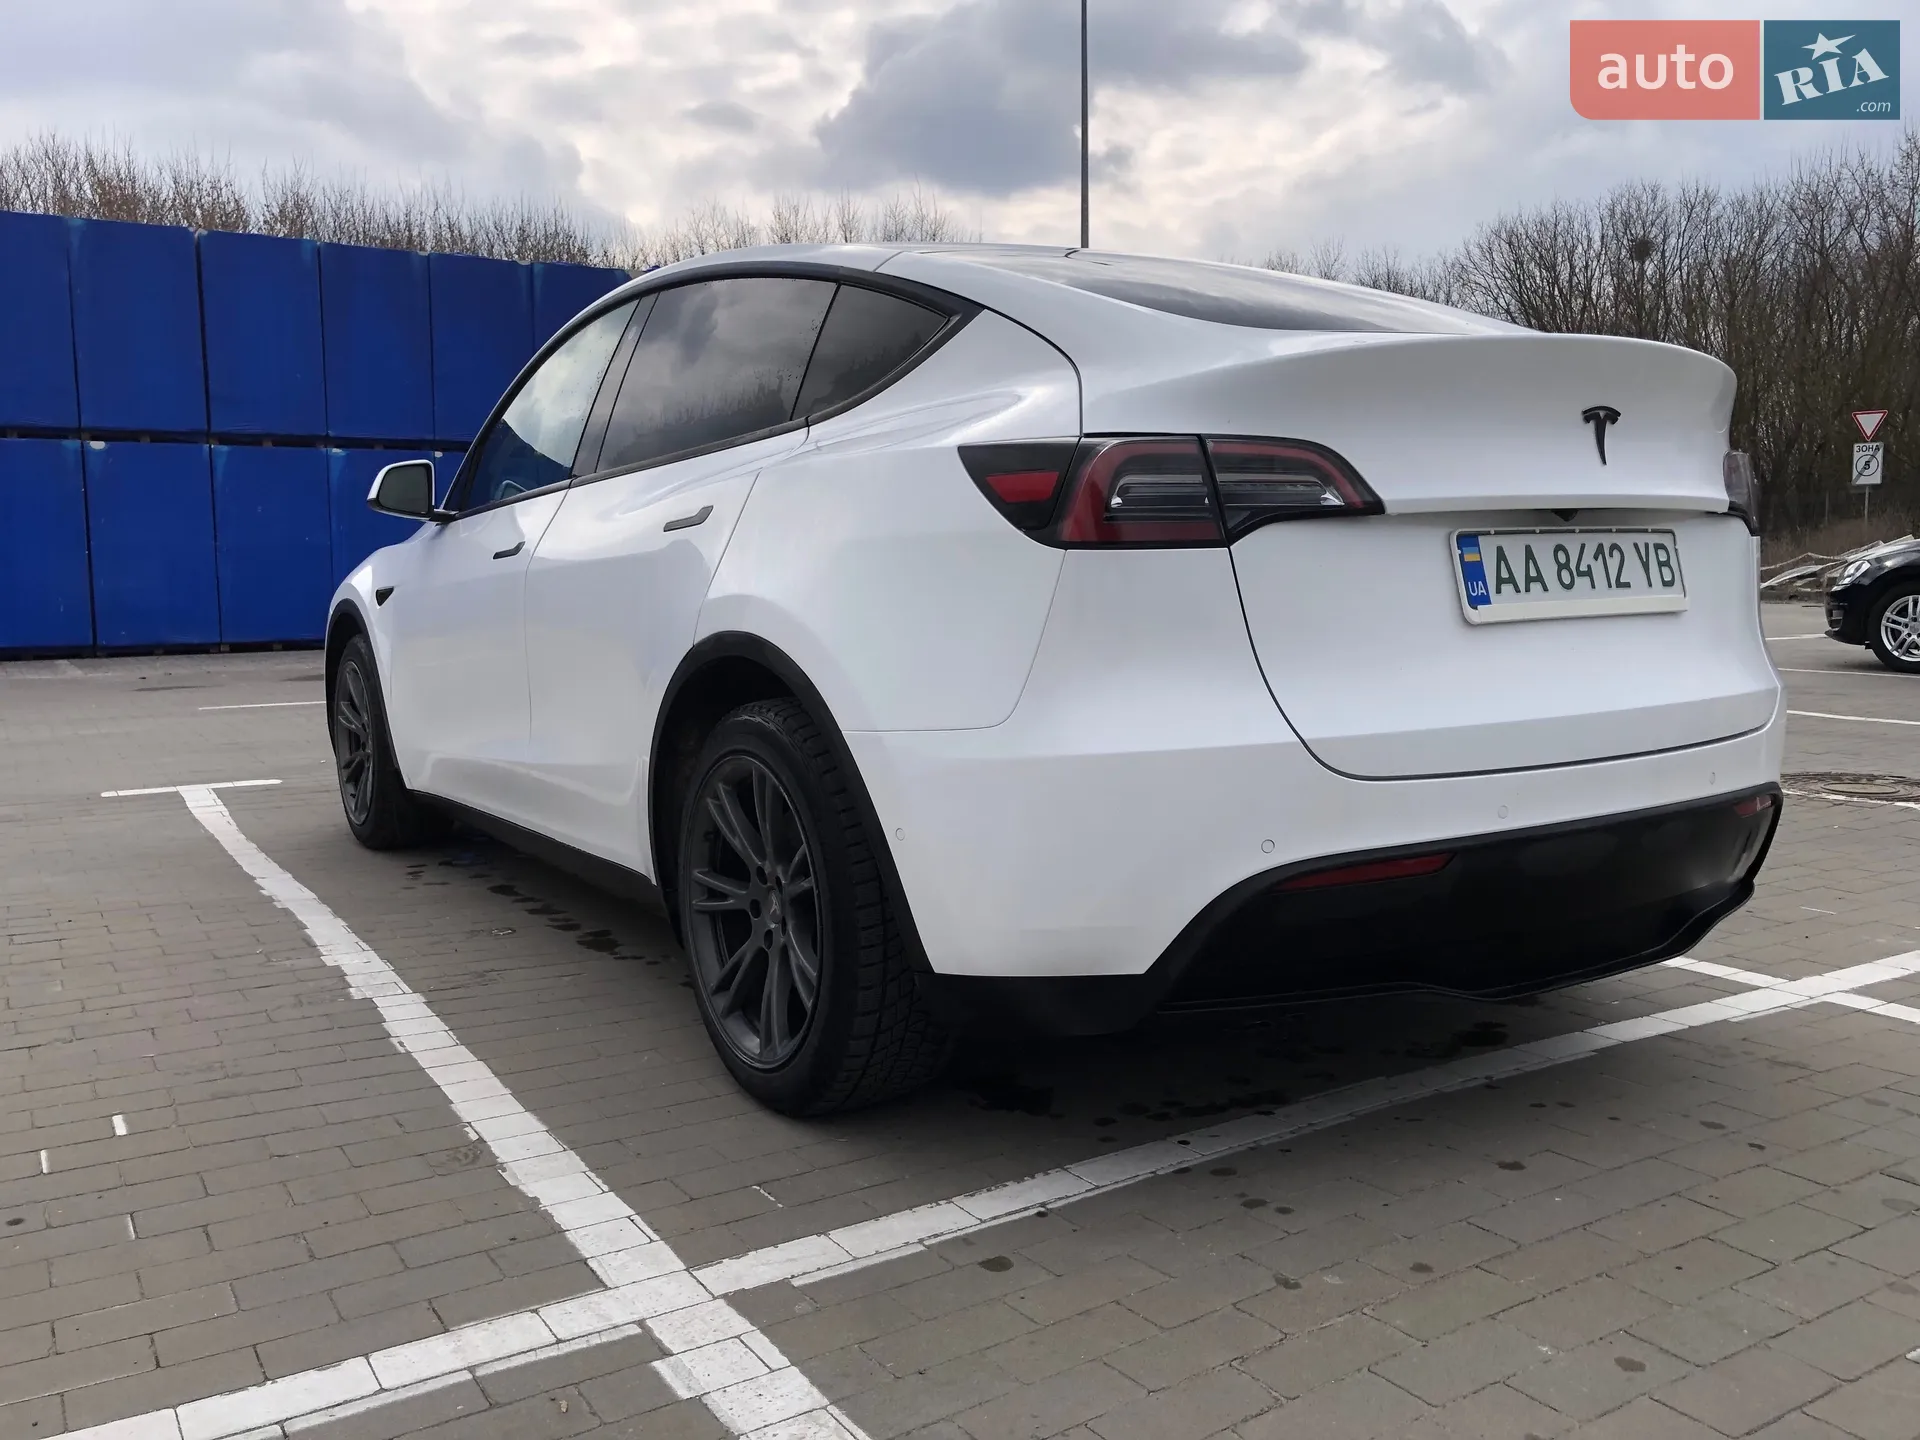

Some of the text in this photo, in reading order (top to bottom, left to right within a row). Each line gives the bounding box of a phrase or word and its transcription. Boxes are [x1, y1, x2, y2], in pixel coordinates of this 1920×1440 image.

[1856, 444, 1880, 452] ЗОНА
[1495, 542, 1676, 594] AA 8412 YB
[1468, 581, 1487, 596] UA
